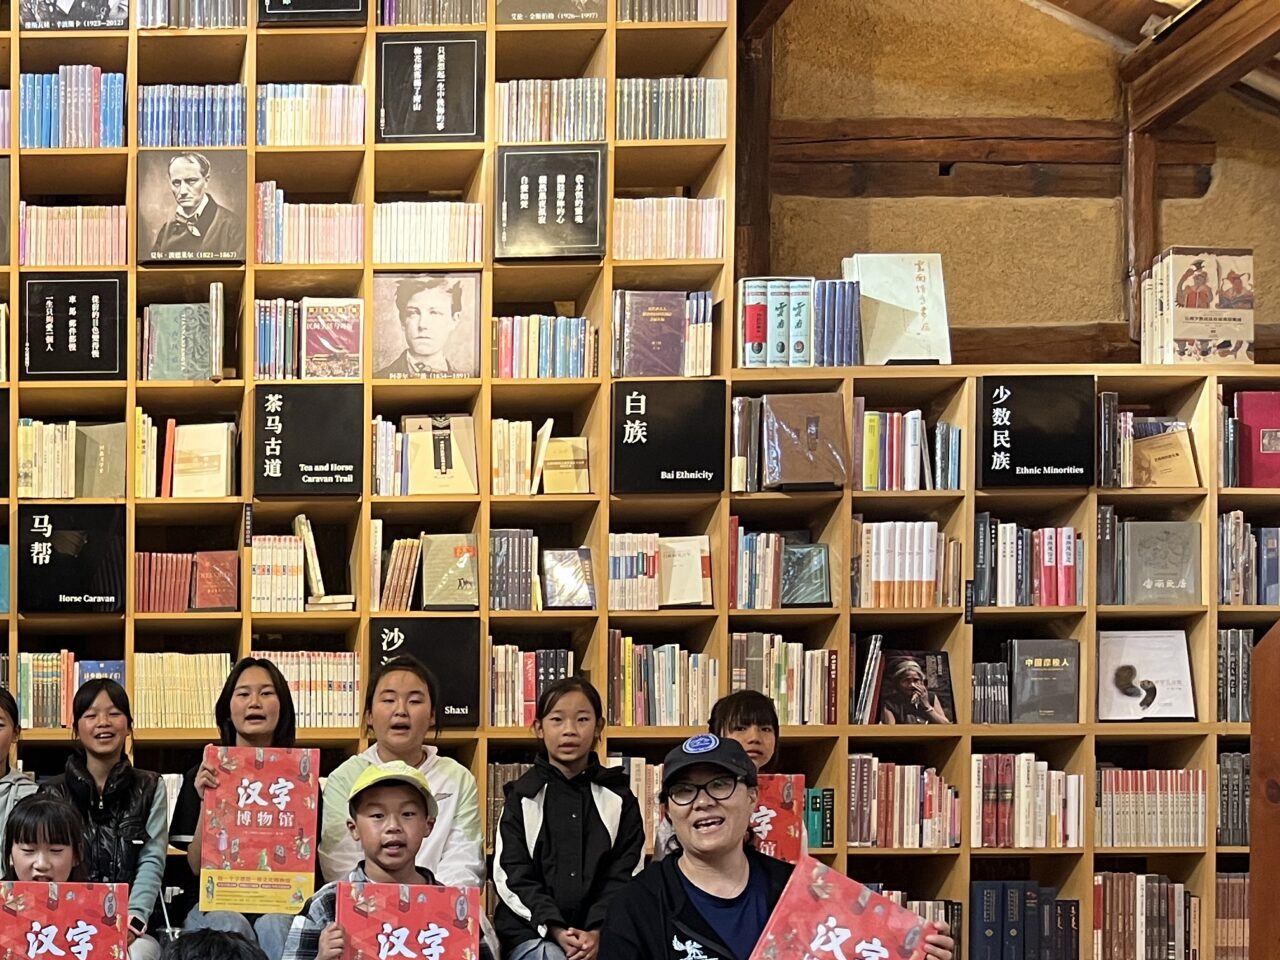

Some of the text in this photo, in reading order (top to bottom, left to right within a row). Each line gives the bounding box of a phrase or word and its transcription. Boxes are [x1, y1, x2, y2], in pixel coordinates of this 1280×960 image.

[622, 390, 648, 444] 白族
[263, 393, 283, 478] 茶马古道
[991, 384, 1012, 471] 少数民族
[299, 463, 354, 472] Tea and Horse
[660, 470, 714, 481] Bai Ethnicity
[1015, 465, 1084, 475] Ethnic Minorities
[302, 474, 354, 483] Caravan Trail
[30, 514, 53, 566] 马帮
[58, 594, 115, 603] Horse Caravan
[380, 627, 405, 666] 沙
[444, 705, 469, 715] Shaxi
[237, 777, 295, 811] 汉字
[236, 811, 295, 827] 博物馆
